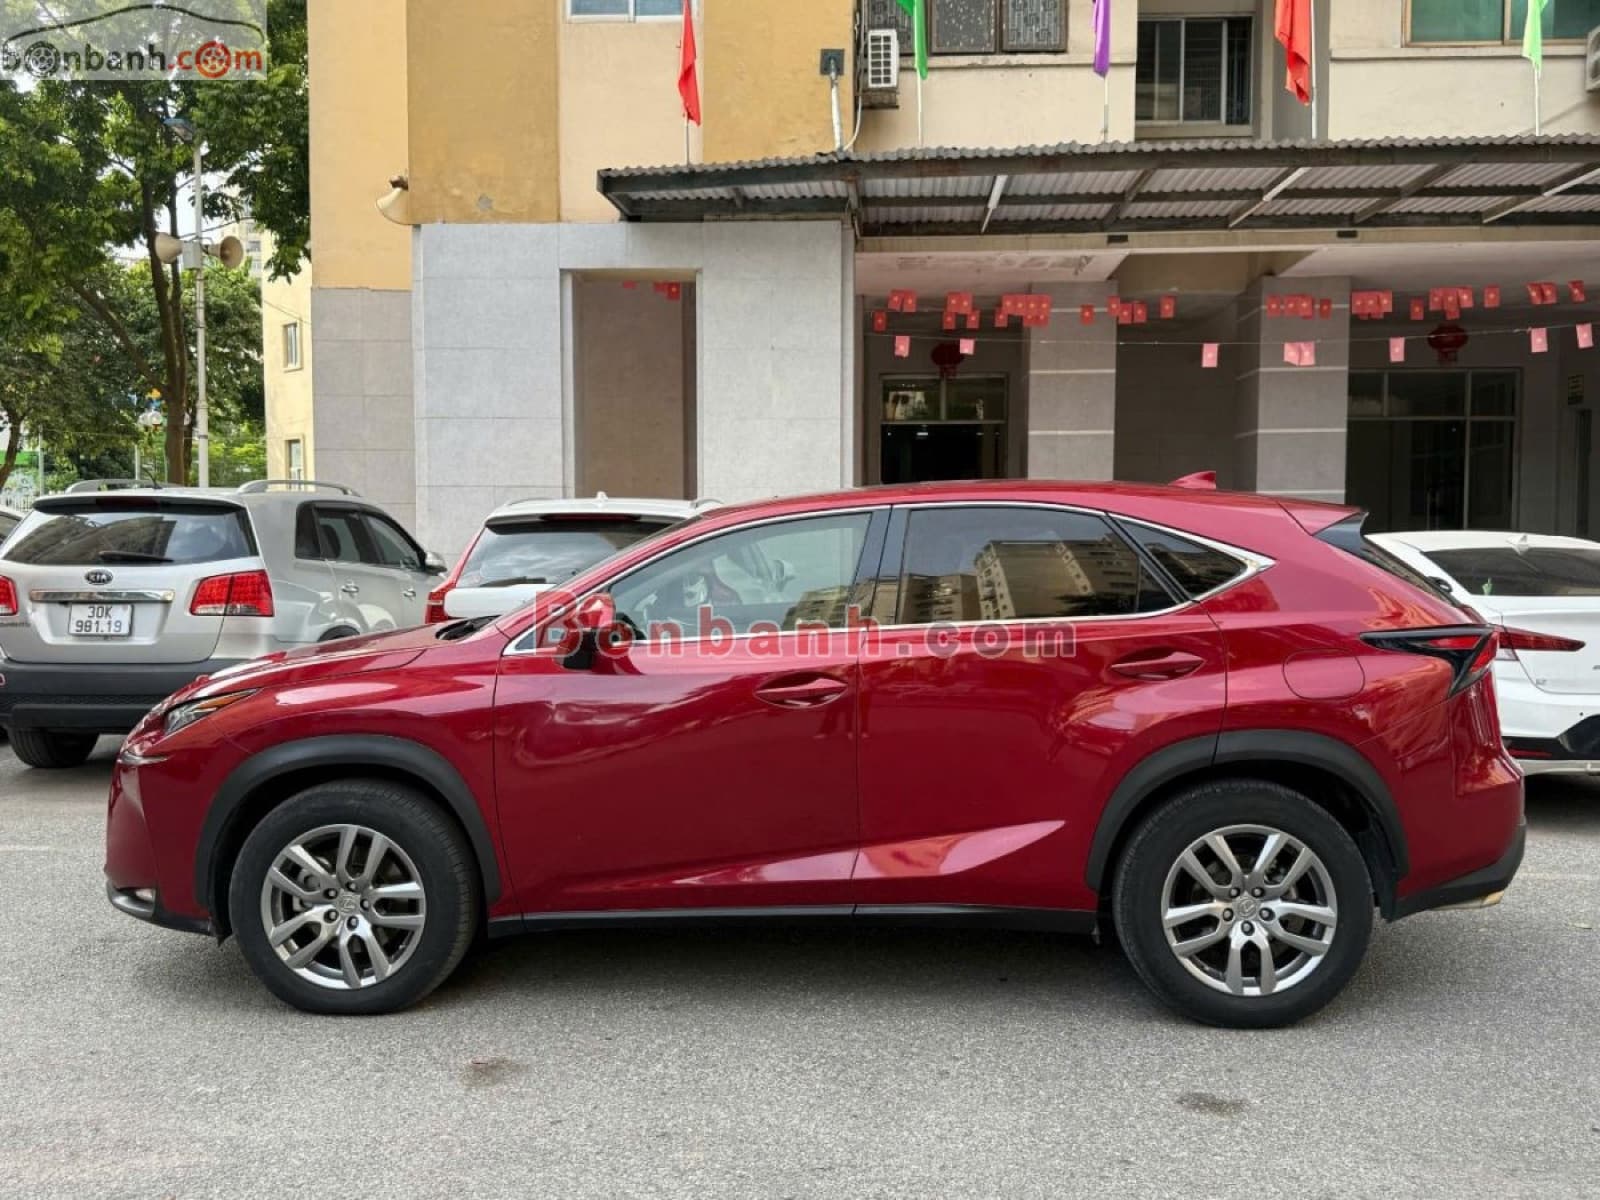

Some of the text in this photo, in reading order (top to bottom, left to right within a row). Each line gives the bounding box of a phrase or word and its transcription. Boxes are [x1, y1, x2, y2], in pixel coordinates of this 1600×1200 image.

[86, 572, 110, 583] KIA
[88, 606, 112, 619] 30K
[75, 620, 121, 633] 981.19
